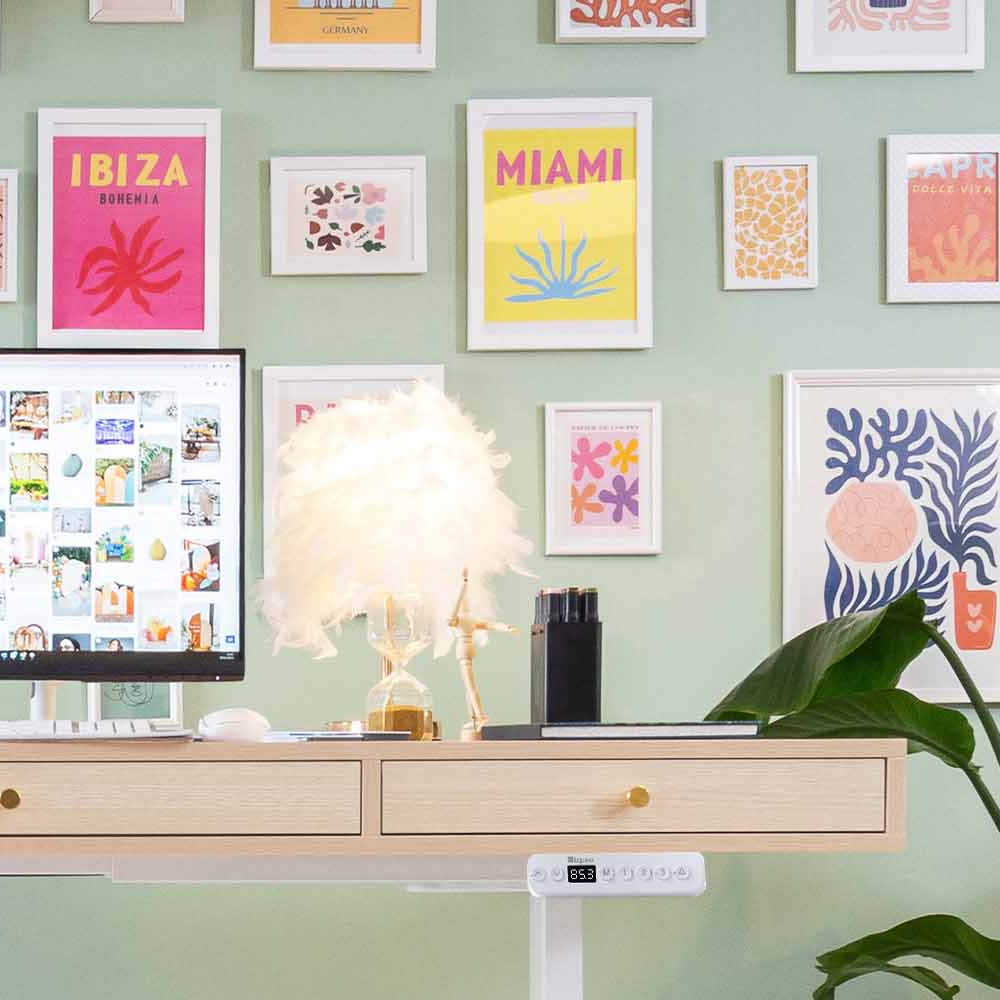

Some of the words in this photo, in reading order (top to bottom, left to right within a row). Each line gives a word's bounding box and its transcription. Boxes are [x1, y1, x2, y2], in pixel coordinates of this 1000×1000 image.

[322, 25, 369, 35] GERMANY
[71, 153, 189, 187] IBIZA
[496, 148, 623, 186] MIAMI
[912, 184, 954, 193] DOLCE
[960, 184, 992, 193] VITA
[99, 193, 160, 205] BOHEMIA
